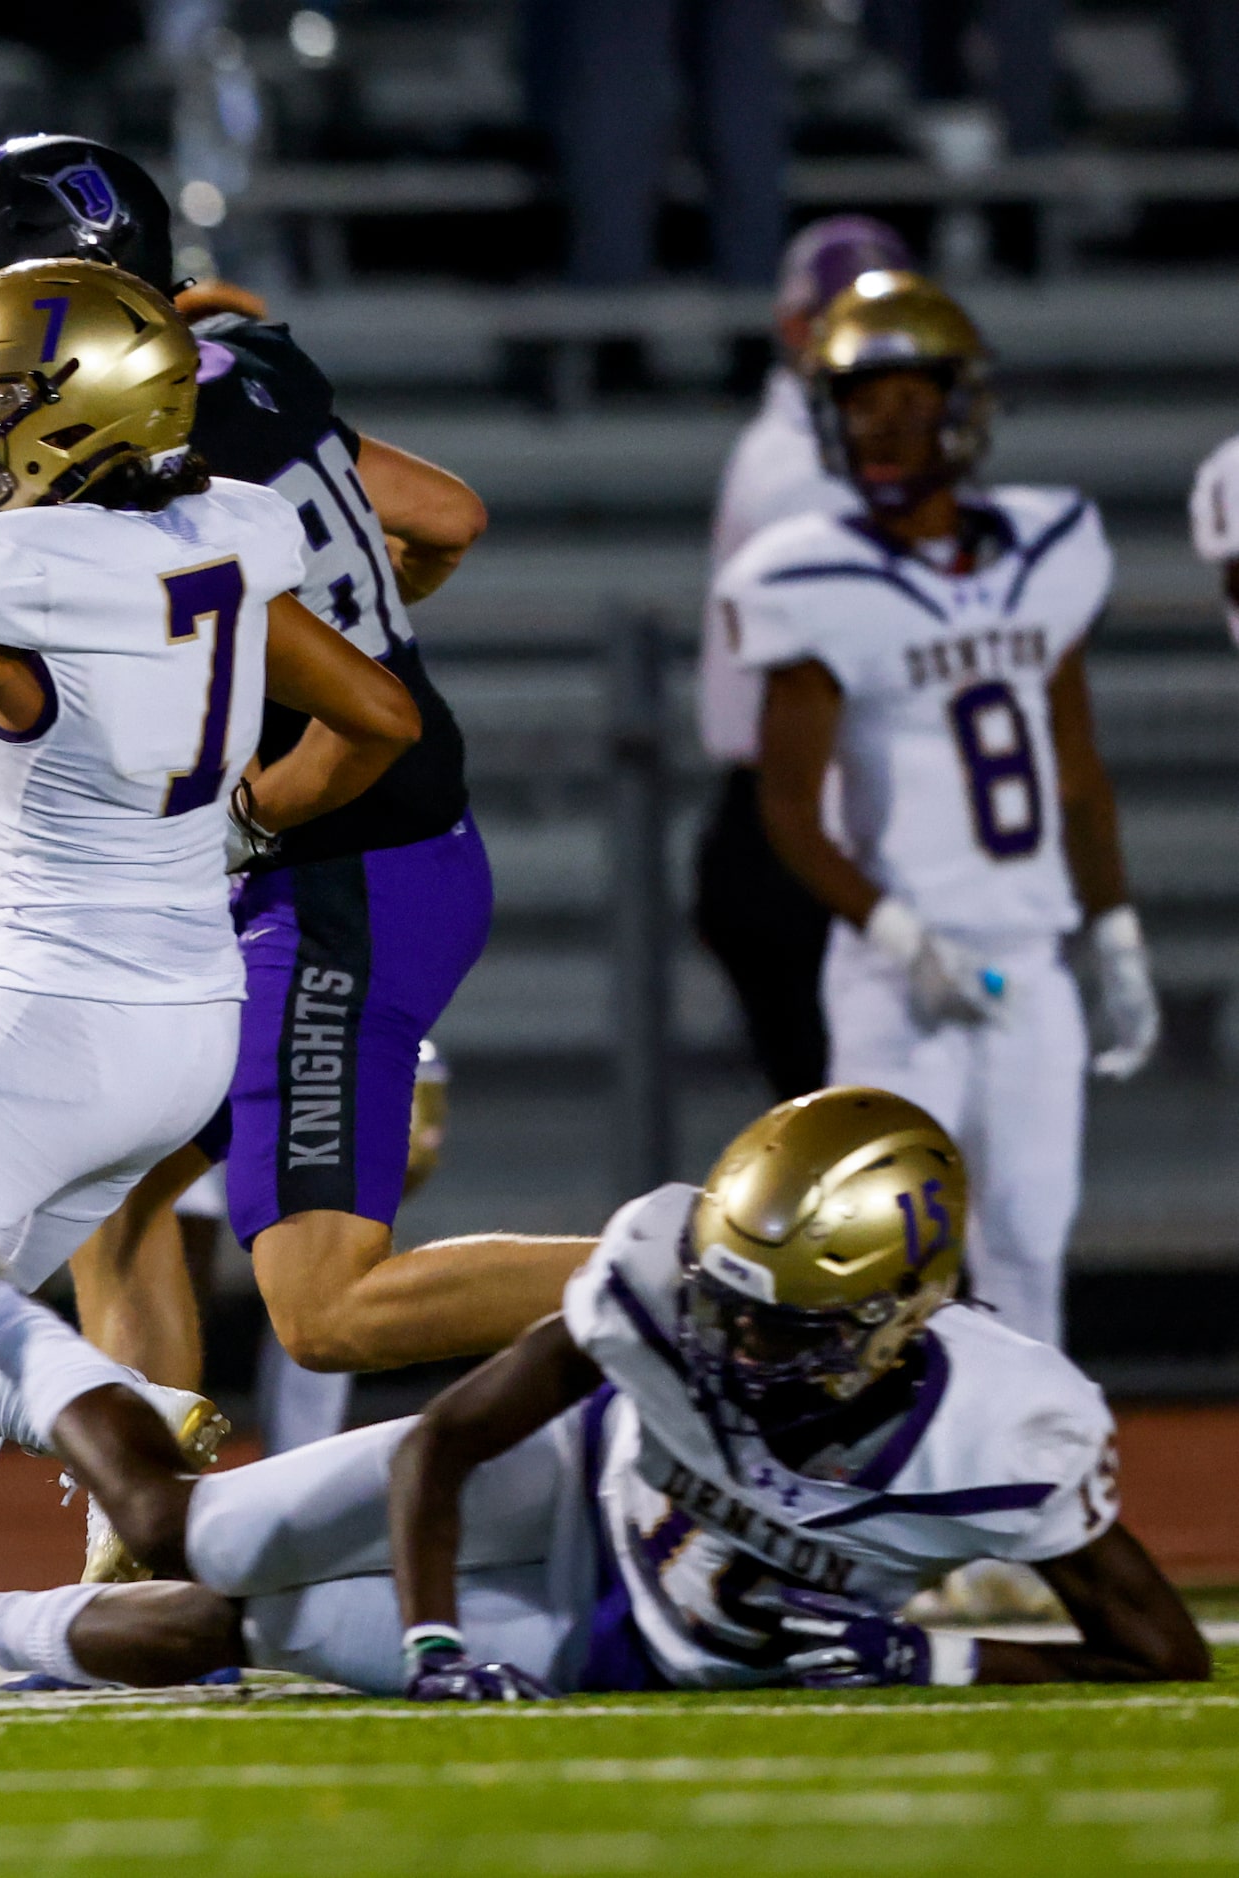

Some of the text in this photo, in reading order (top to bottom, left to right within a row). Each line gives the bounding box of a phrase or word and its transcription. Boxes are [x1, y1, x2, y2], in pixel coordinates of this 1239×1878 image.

[32, 297, 70, 363] 7
[157, 553, 245, 819] 7
[945, 680, 1044, 862] 8
[288, 965, 355, 1170] KNIGHTS
[895, 1178, 951, 1266] 15
[664, 1459, 854, 1594] DENTON
